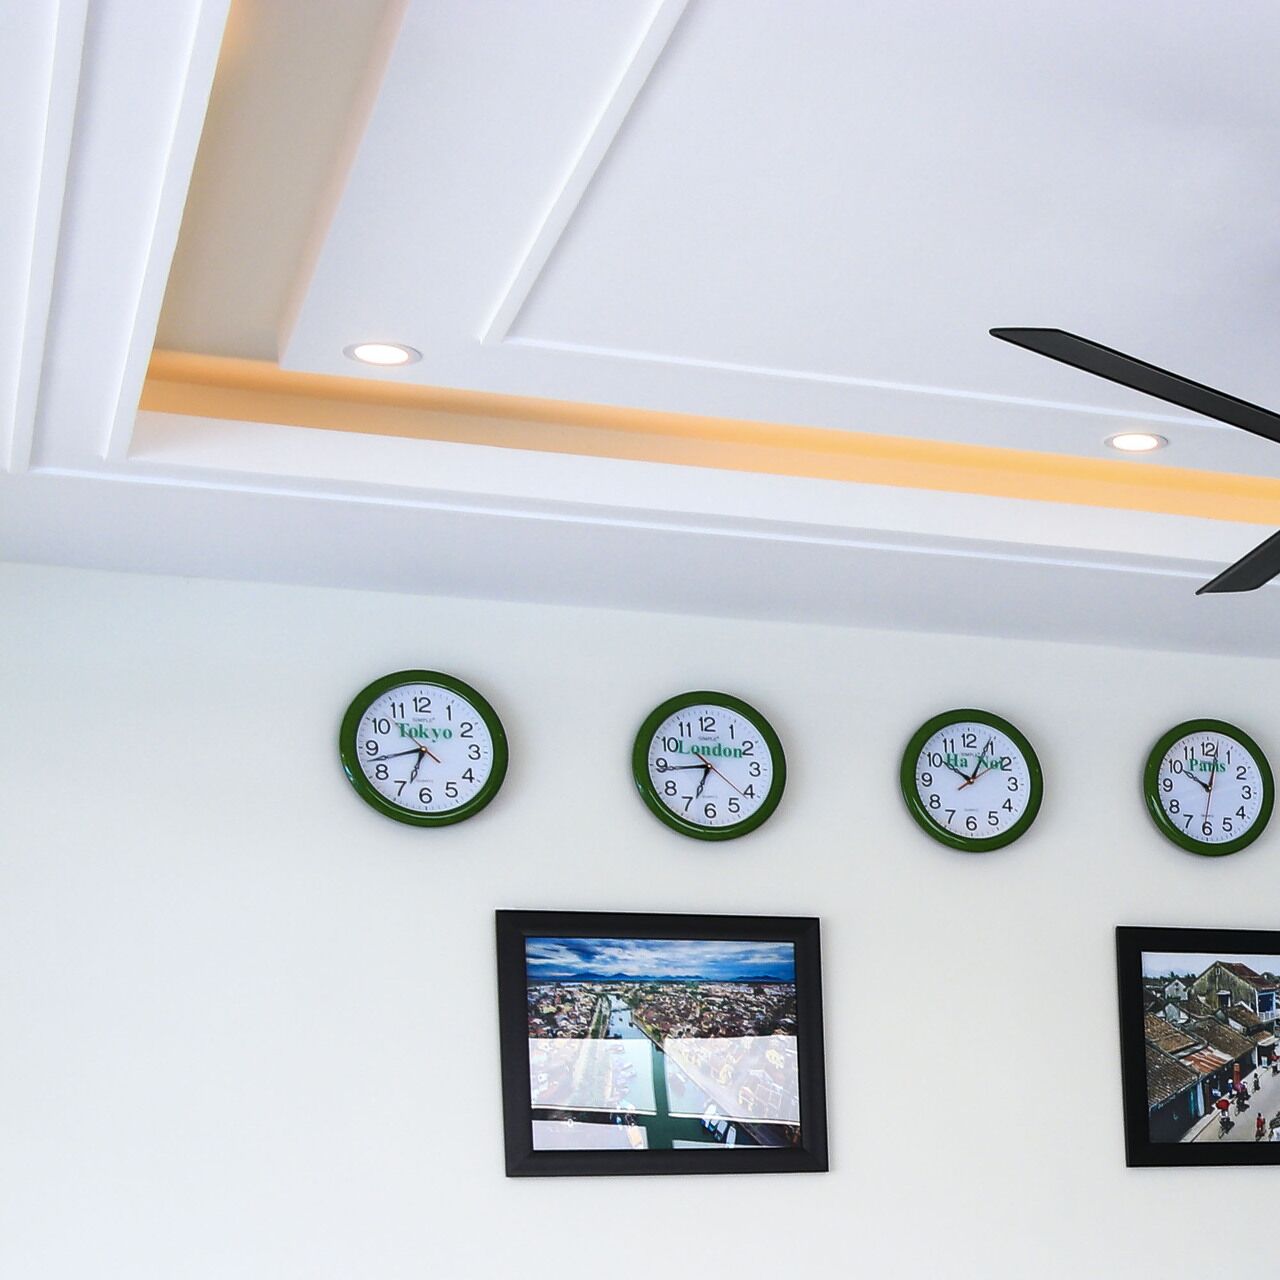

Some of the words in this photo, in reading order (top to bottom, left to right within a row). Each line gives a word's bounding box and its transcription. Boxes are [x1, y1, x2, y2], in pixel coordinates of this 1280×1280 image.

[391, 702, 404, 718] 11
[413, 697, 431, 713] 12
[446, 705, 451, 720] 1
[372, 718, 390, 734] 10
[460, 723, 473, 738] 2
[679, 722, 691, 737] 11
[699, 717, 715, 732] 12
[729, 724, 734, 739] 1
[396, 722, 453, 742] Tokyo
[366, 740, 378, 755] 9
[662, 737, 678, 752] 10
[742, 741, 753, 755] 2
[943, 739, 954, 753] 11
[962, 734, 977, 748] 12
[990, 741, 994, 755] 1
[468, 745, 481, 760] 3
[678, 740, 742, 758] London
[1184, 746, 1194, 760] 11
[1201, 742, 1216, 756] 12
[927, 753, 942, 767] 10
[946, 753, 968, 767] Ha
[1001, 757, 1012, 771] 2
[1227, 750, 1230, 764] 1
[376, 764, 388, 780] 8
[656, 758, 668, 773] 9
[749, 762, 761, 777] 3
[1169, 759, 1182, 774] 10
[1189, 759, 1226, 772] Paris
[462, 768, 475, 783] 4
[922, 773, 932, 787] 9
[1236, 766, 1246, 780] 2
[394, 781, 406, 796] 7
[445, 782, 458, 797] 5
[665, 781, 677, 796] 8
[1008, 777, 1018, 791] 3
[1163, 778, 1173, 792] 9
[419, 788, 432, 803] 6
[744, 785, 755, 798] 4
[1242, 786, 1251, 799] 3
[682, 797, 693, 811] 7
[728, 798, 740, 812] 5
[930, 794, 941, 809] 8
[1002, 798, 1013, 812] 4
[1169, 799, 1180, 814] 8
[705, 803, 716, 818] 6
[945, 810, 956, 824] 7
[1236, 806, 1246, 819] 4
[966, 816, 977, 831] 6
[988, 811, 999, 825] 5
[1184, 814, 1193, 828] 7
[1222, 818, 1232, 832] 5
[1202, 822, 1212, 835] 6
